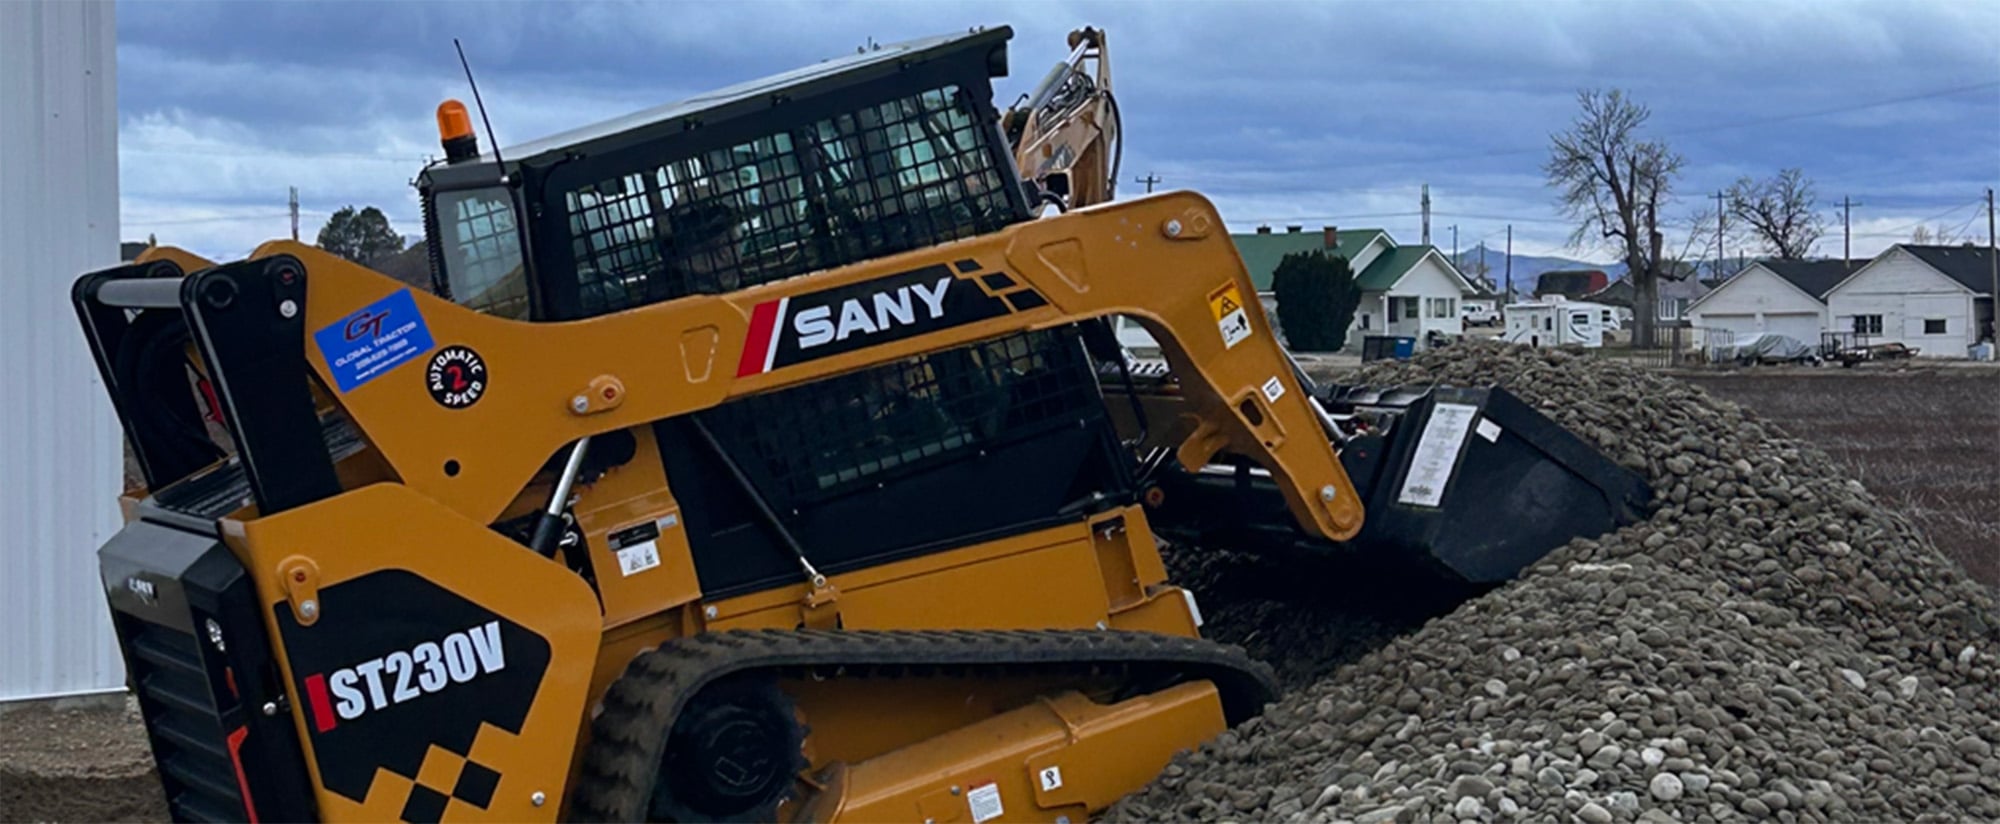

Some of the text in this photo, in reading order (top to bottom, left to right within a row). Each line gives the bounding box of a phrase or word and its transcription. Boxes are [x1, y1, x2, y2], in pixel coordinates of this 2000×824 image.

[344, 310, 391, 341] GT
[793, 277, 951, 349] SANY
[430, 349, 484, 392] AUTOMATIC
[447, 366, 468, 390] 2
[444, 381, 483, 406] SPEED
[329, 620, 506, 720] ST230V
